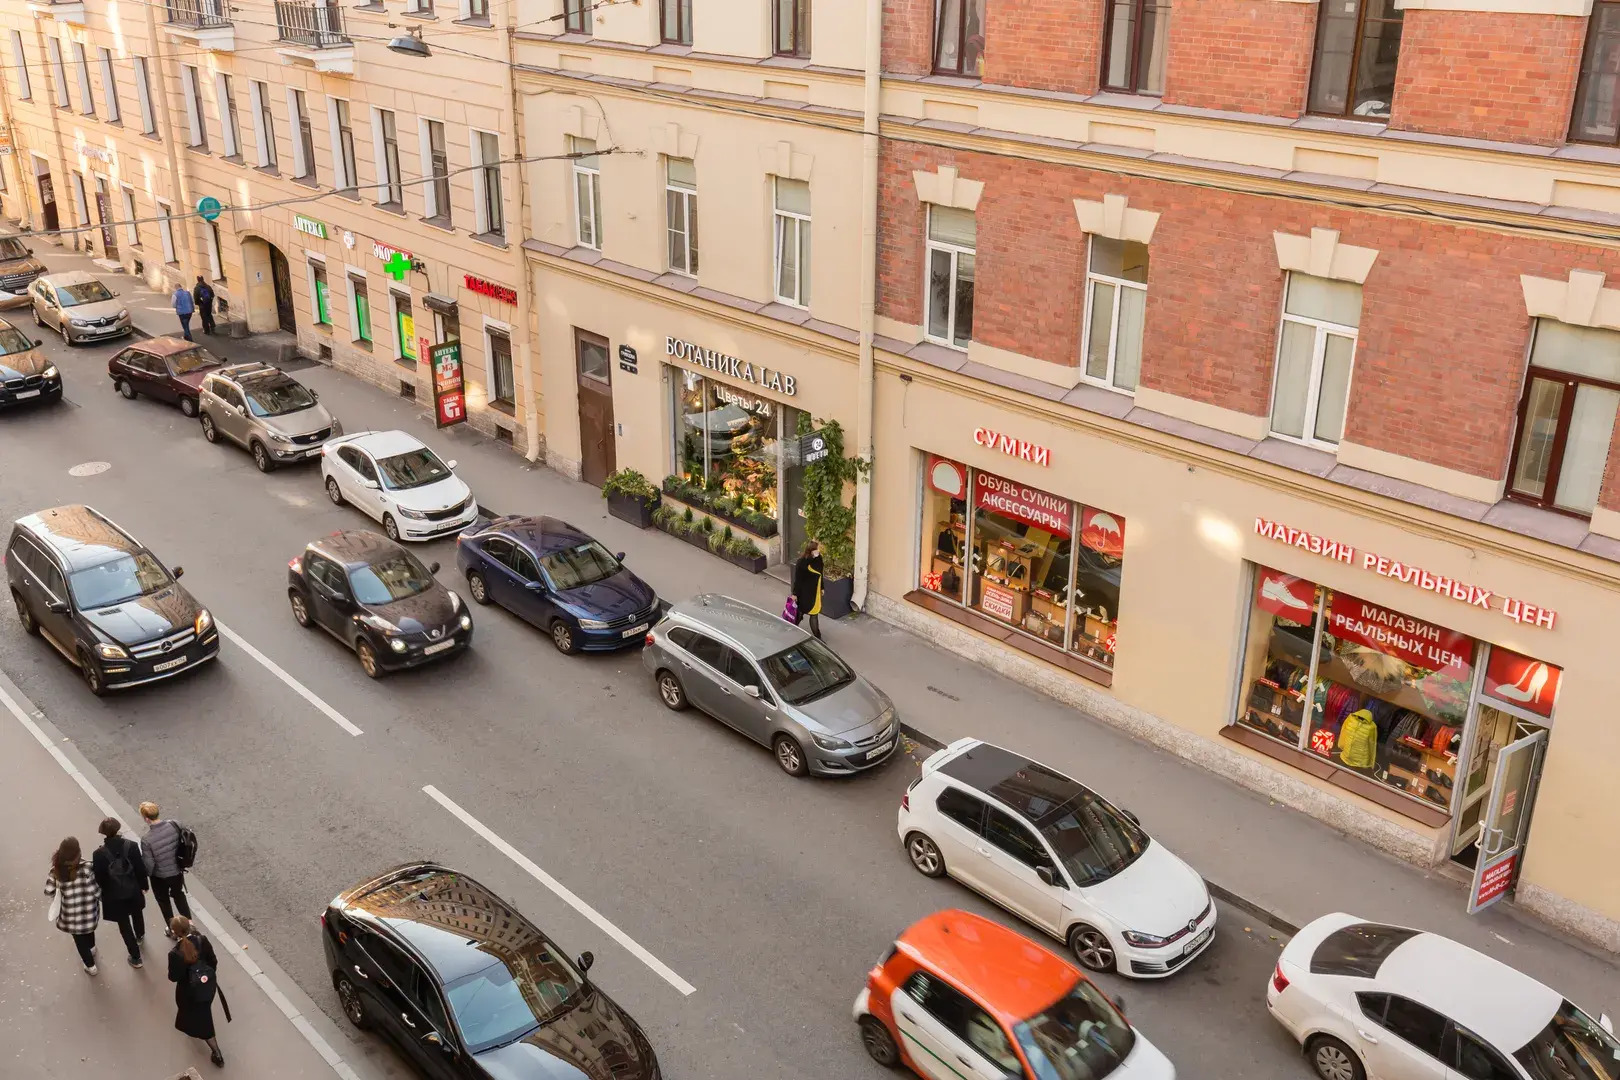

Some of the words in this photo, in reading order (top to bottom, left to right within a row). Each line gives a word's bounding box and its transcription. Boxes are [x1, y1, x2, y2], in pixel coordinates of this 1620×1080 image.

[293, 216, 324, 239] АПТЕКА
[373, 243, 409, 262] ЭКОМ
[435, 345, 458, 356] АПТЕКА
[666, 336, 757, 384] БОТАНИКА
[443, 396, 459, 404] ТАБАК
[716, 386, 752, 411] Цветы
[755, 400, 770, 417] 24
[973, 427, 1051, 467] СУМКИ
[978, 473, 1019, 497] ОБУВЬ
[1021, 489, 1068, 515] СУМКИ
[982, 491, 1062, 530] АКСЕССУАРЫ
[1254, 517, 1355, 564] МАГАЗИН
[1363, 552, 1491, 610] РЕАЛЬНЫХ
[1502, 595, 1557, 630] ЦЕН
[984, 601, 1011, 617] СКИДКИ
[1361, 604, 1440, 642] МАГАЗИН
[1336, 613, 1424, 656] РЕАЛЬНЫХ
[1427, 645, 1462, 669] ЦЕН
